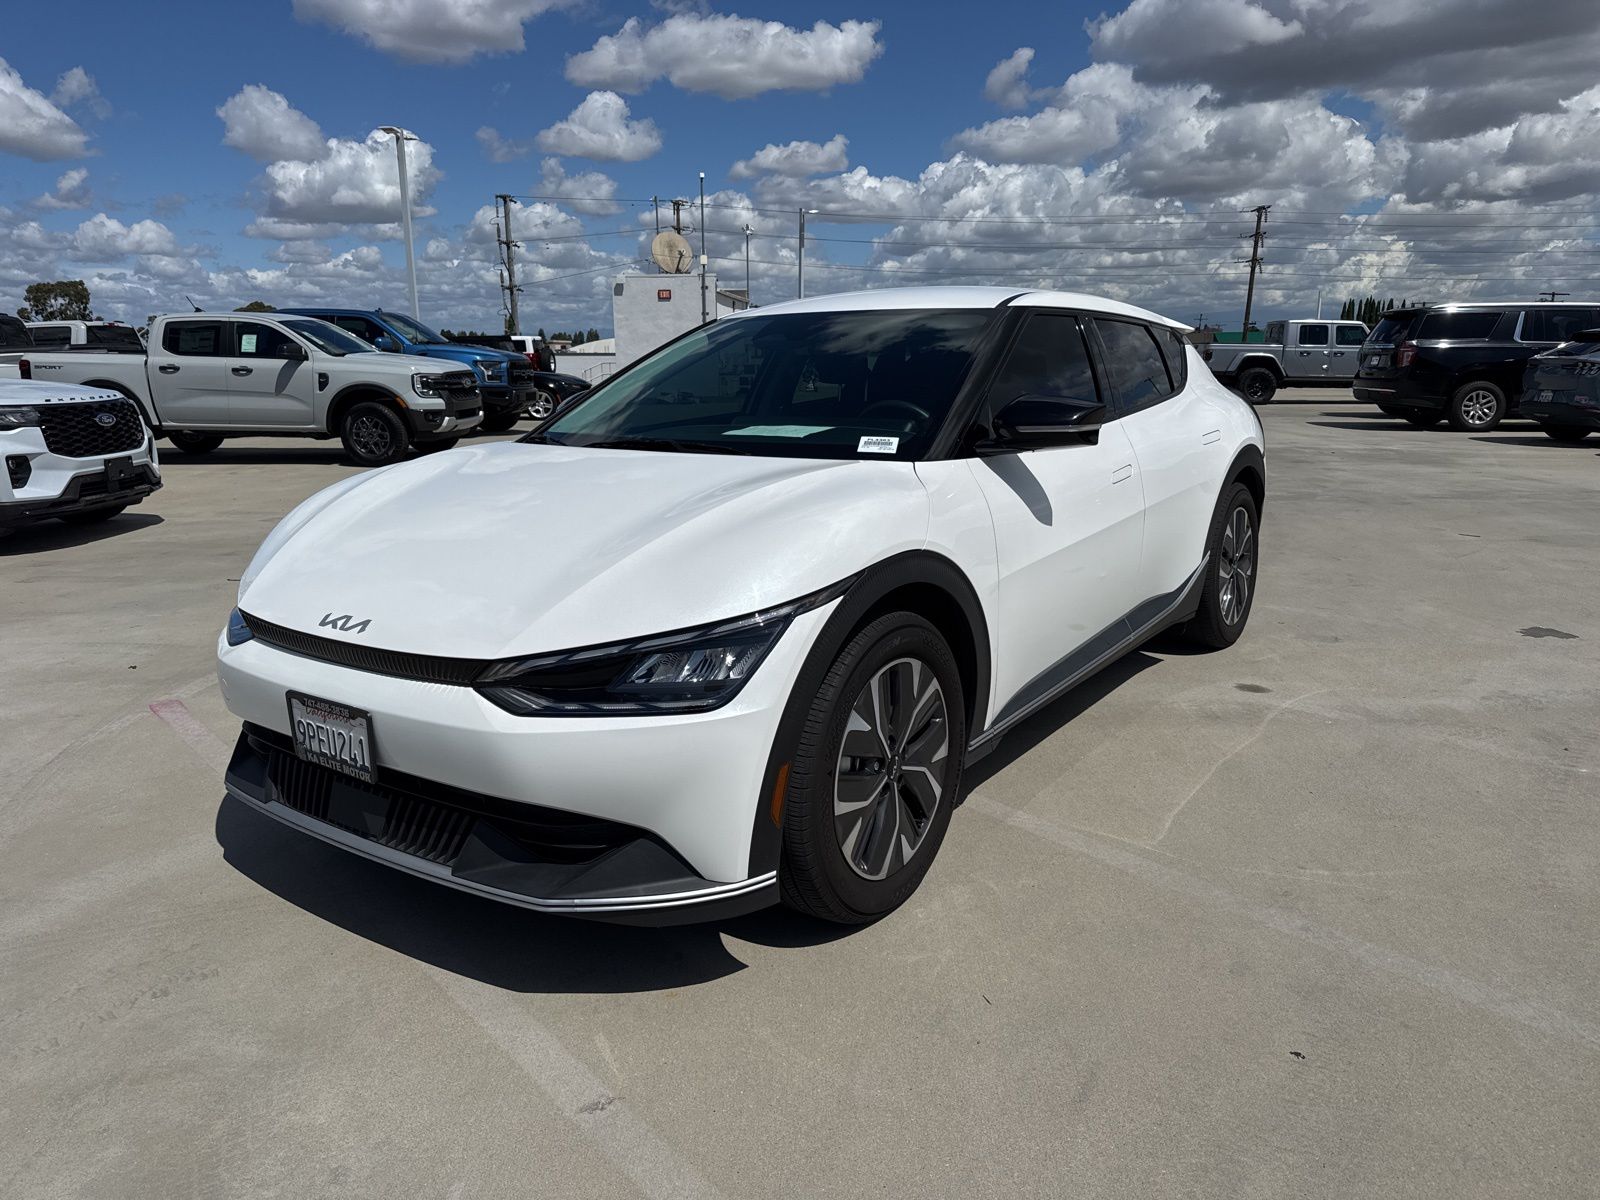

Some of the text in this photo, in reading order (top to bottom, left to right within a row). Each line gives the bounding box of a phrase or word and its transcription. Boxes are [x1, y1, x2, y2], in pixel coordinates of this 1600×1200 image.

[44, 394, 118, 402] EXPLORER
[318, 612, 373, 634] KIA
[297, 718, 371, 772] 9PEU241
[320, 756, 342, 772] ELITE
[343, 764, 372, 783] MOTOR
